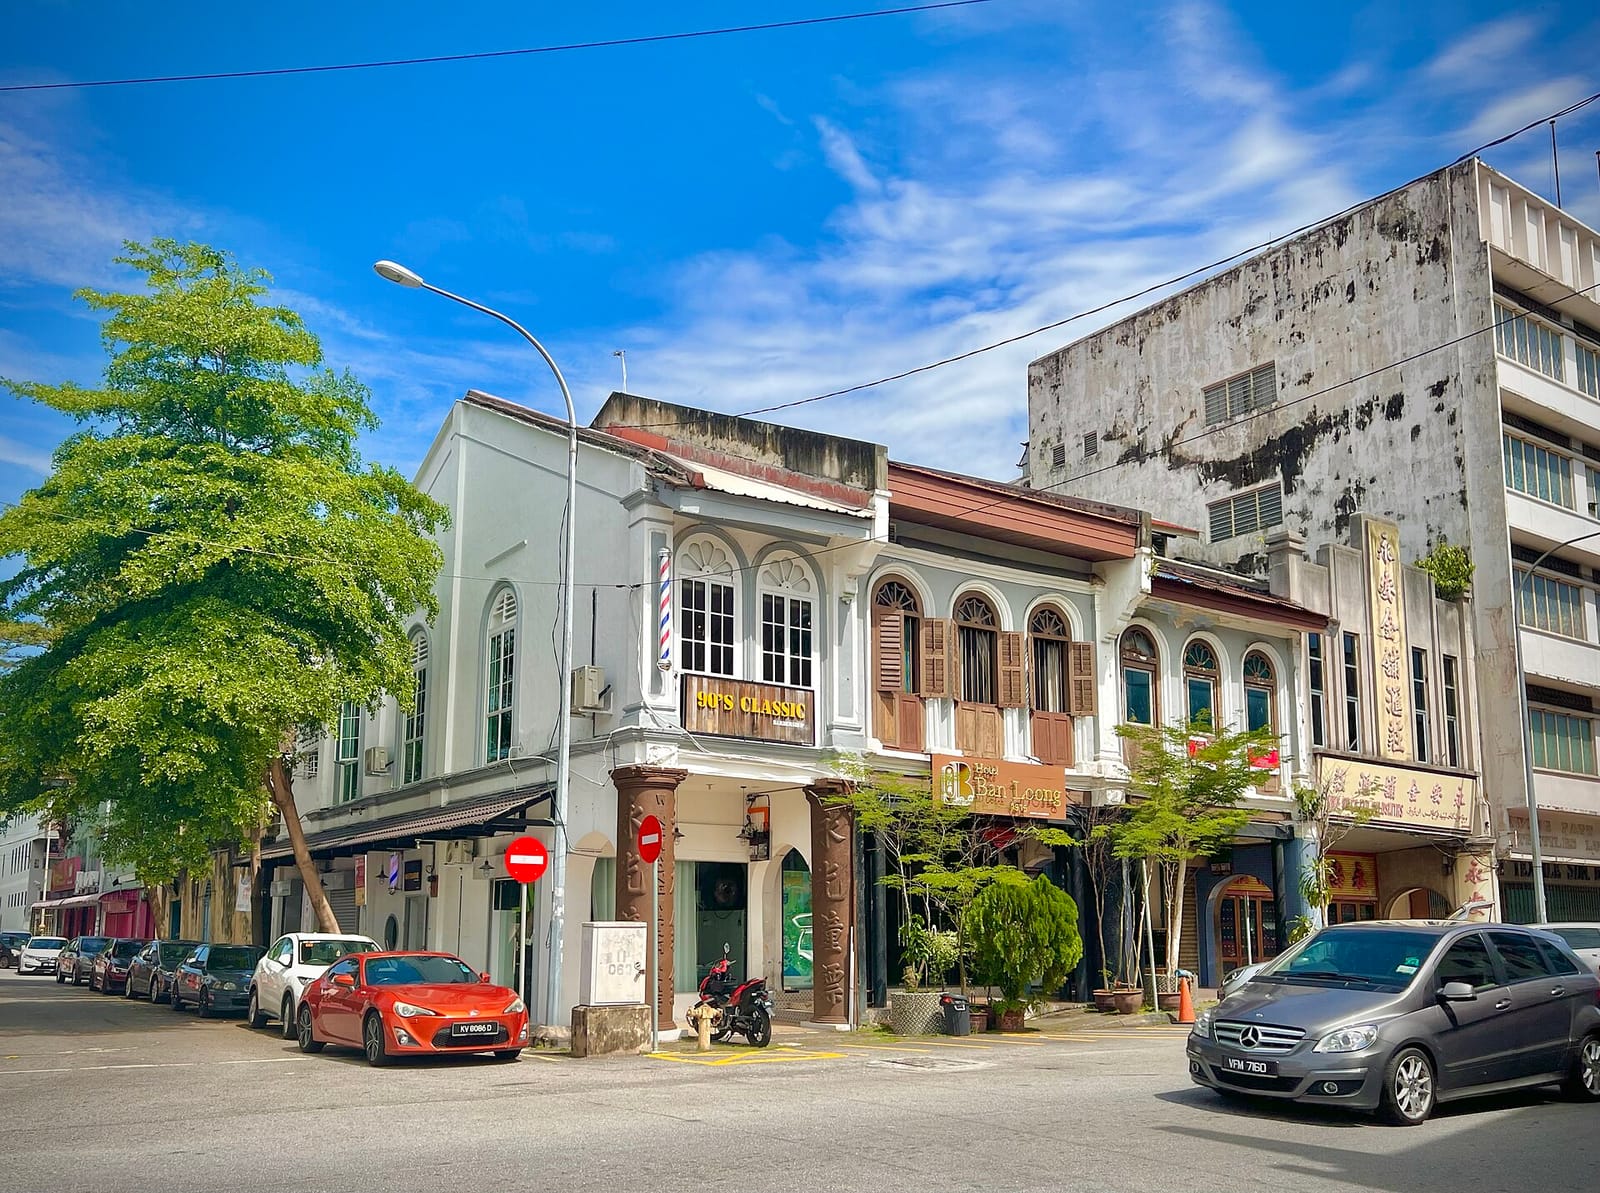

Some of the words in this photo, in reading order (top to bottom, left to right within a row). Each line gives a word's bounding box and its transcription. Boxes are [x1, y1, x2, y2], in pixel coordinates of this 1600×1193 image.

[697, 690, 734, 711] 90'S
[740, 696, 806, 720] CLASSIC
[974, 762, 999, 775] Hotel
[974, 776, 1007, 798] Ban
[1009, 780, 1062, 807] Loong
[1228, 1058, 1244, 1070] VFM
[1246, 1061, 1267, 1073] 7160
